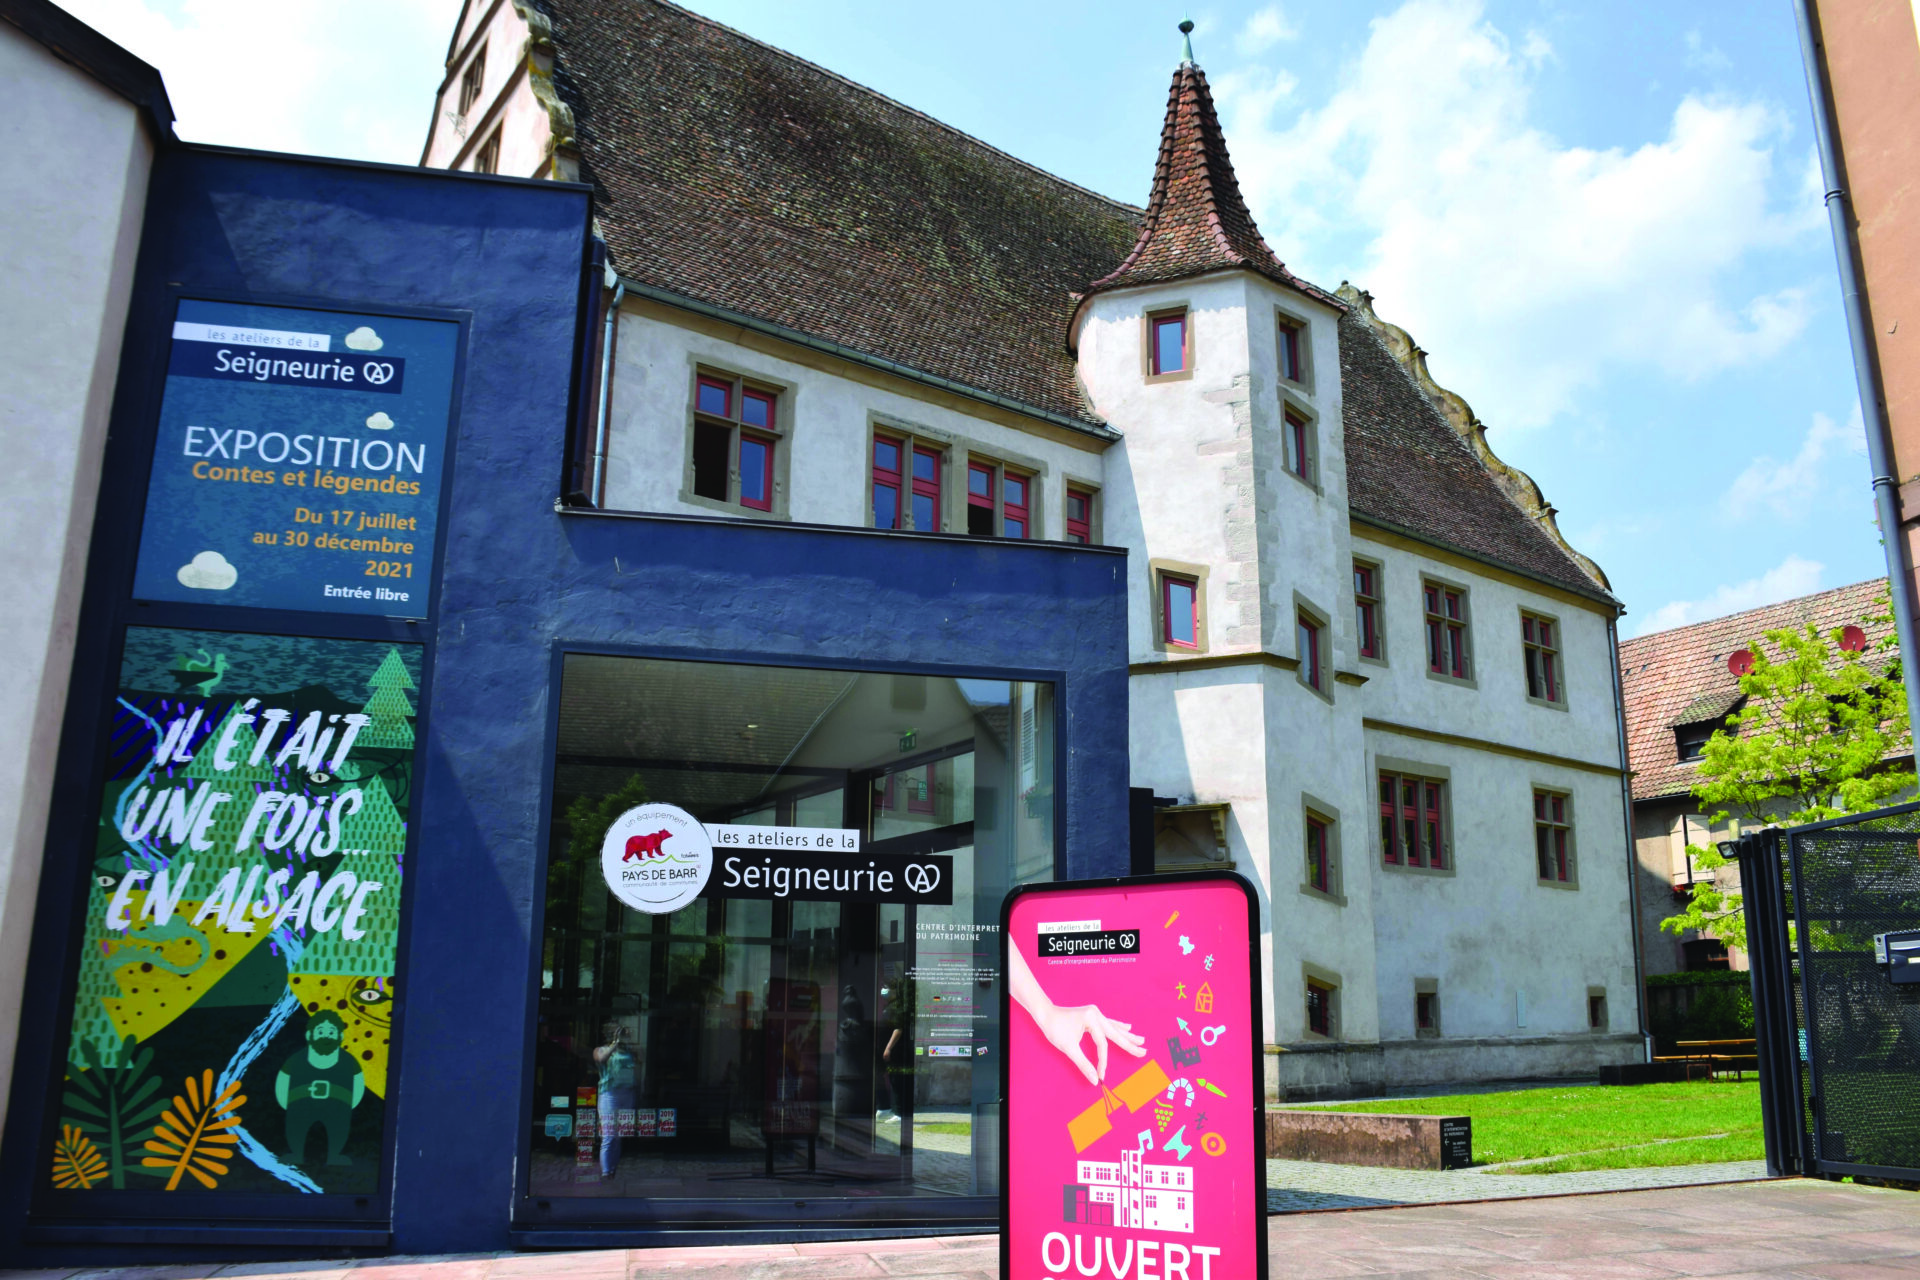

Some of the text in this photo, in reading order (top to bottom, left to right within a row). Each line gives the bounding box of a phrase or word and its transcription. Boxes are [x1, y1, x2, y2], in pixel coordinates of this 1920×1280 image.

[207, 328, 320, 349] les ateliers de la
[214, 349, 355, 382] Seigneurie
[183, 425, 426, 474] EXPOSITION
[192, 461, 421, 495] Contes et légendes
[294, 507, 418, 532] Du 17 juillet
[252, 530, 415, 555] au 30 décembre
[364, 560, 414, 579] 2021
[323, 584, 410, 602] Entrée libre
[156, 708, 204, 766] IL
[121, 782, 233, 851] UNE
[717, 829, 856, 849] les ateliers de la
[622, 866, 698, 882] PAYS DE BARR
[723, 856, 895, 898] Seigneurie
[105, 861, 383, 942] EN ALSACE
[915, 923, 946, 932] CENTRE
[915, 932, 981, 941] DU PATRIMOINE
[1045, 924, 1055, 932] les
[1057, 922, 1081, 931] ateliers
[1083, 922, 1091, 930] de
[1048, 933, 1116, 955] Seigneurie
[1041, 1231, 1221, 1280] OUVERT
